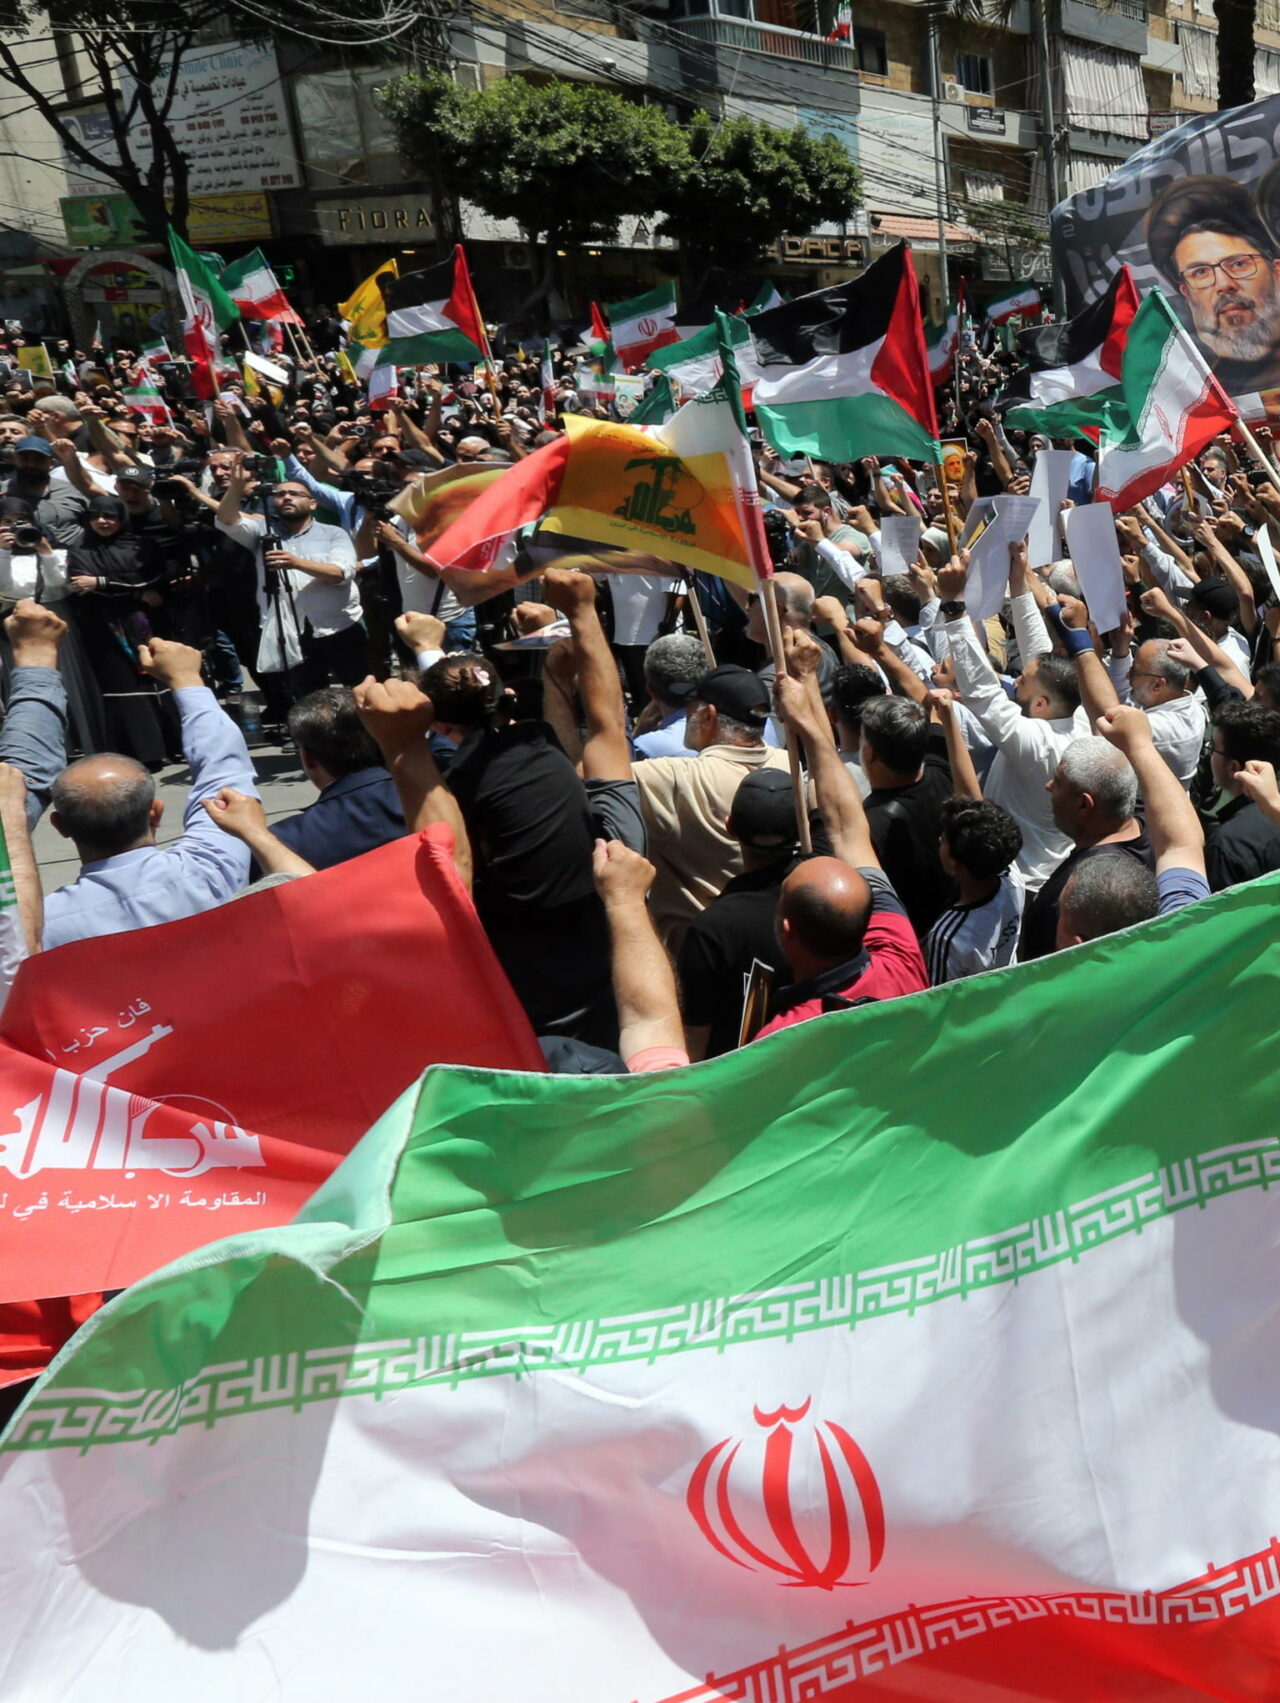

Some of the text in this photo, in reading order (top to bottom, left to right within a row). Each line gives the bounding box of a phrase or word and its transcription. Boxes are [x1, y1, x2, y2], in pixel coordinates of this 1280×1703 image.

[209, 51, 243, 70] Clinic
[116, 996, 153, 1031] فان
[63, 1025, 109, 1055] حزب
[12, 1193, 48, 1224] في
[58, 1191, 136, 1214] سلامية
[180, 1191, 267, 1212] المقاومة
